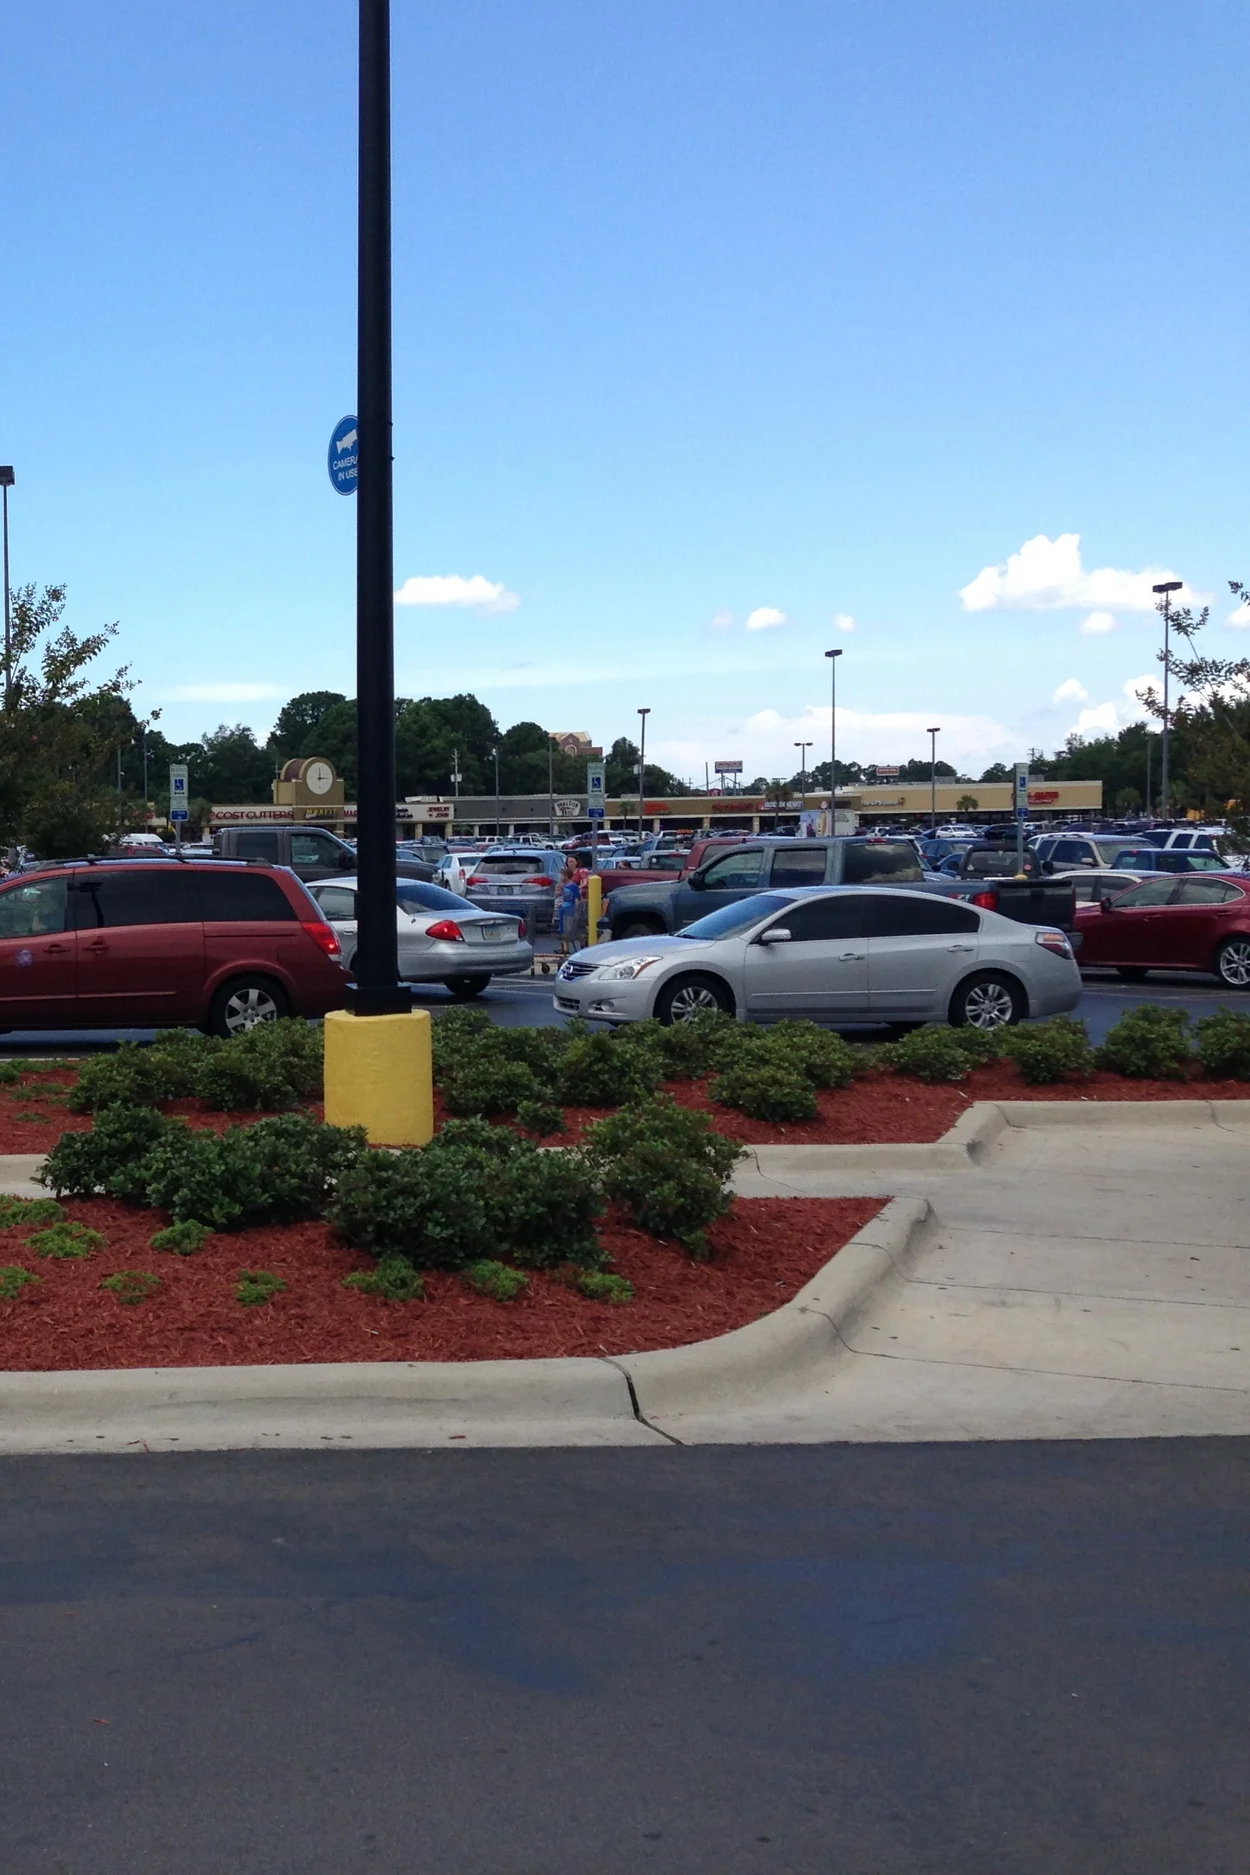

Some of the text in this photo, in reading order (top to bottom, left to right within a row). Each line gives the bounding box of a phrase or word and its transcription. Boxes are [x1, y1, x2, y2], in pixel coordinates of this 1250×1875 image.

[338, 472, 345, 481] IN
[216, 810, 294, 820] COST CUTTERS
